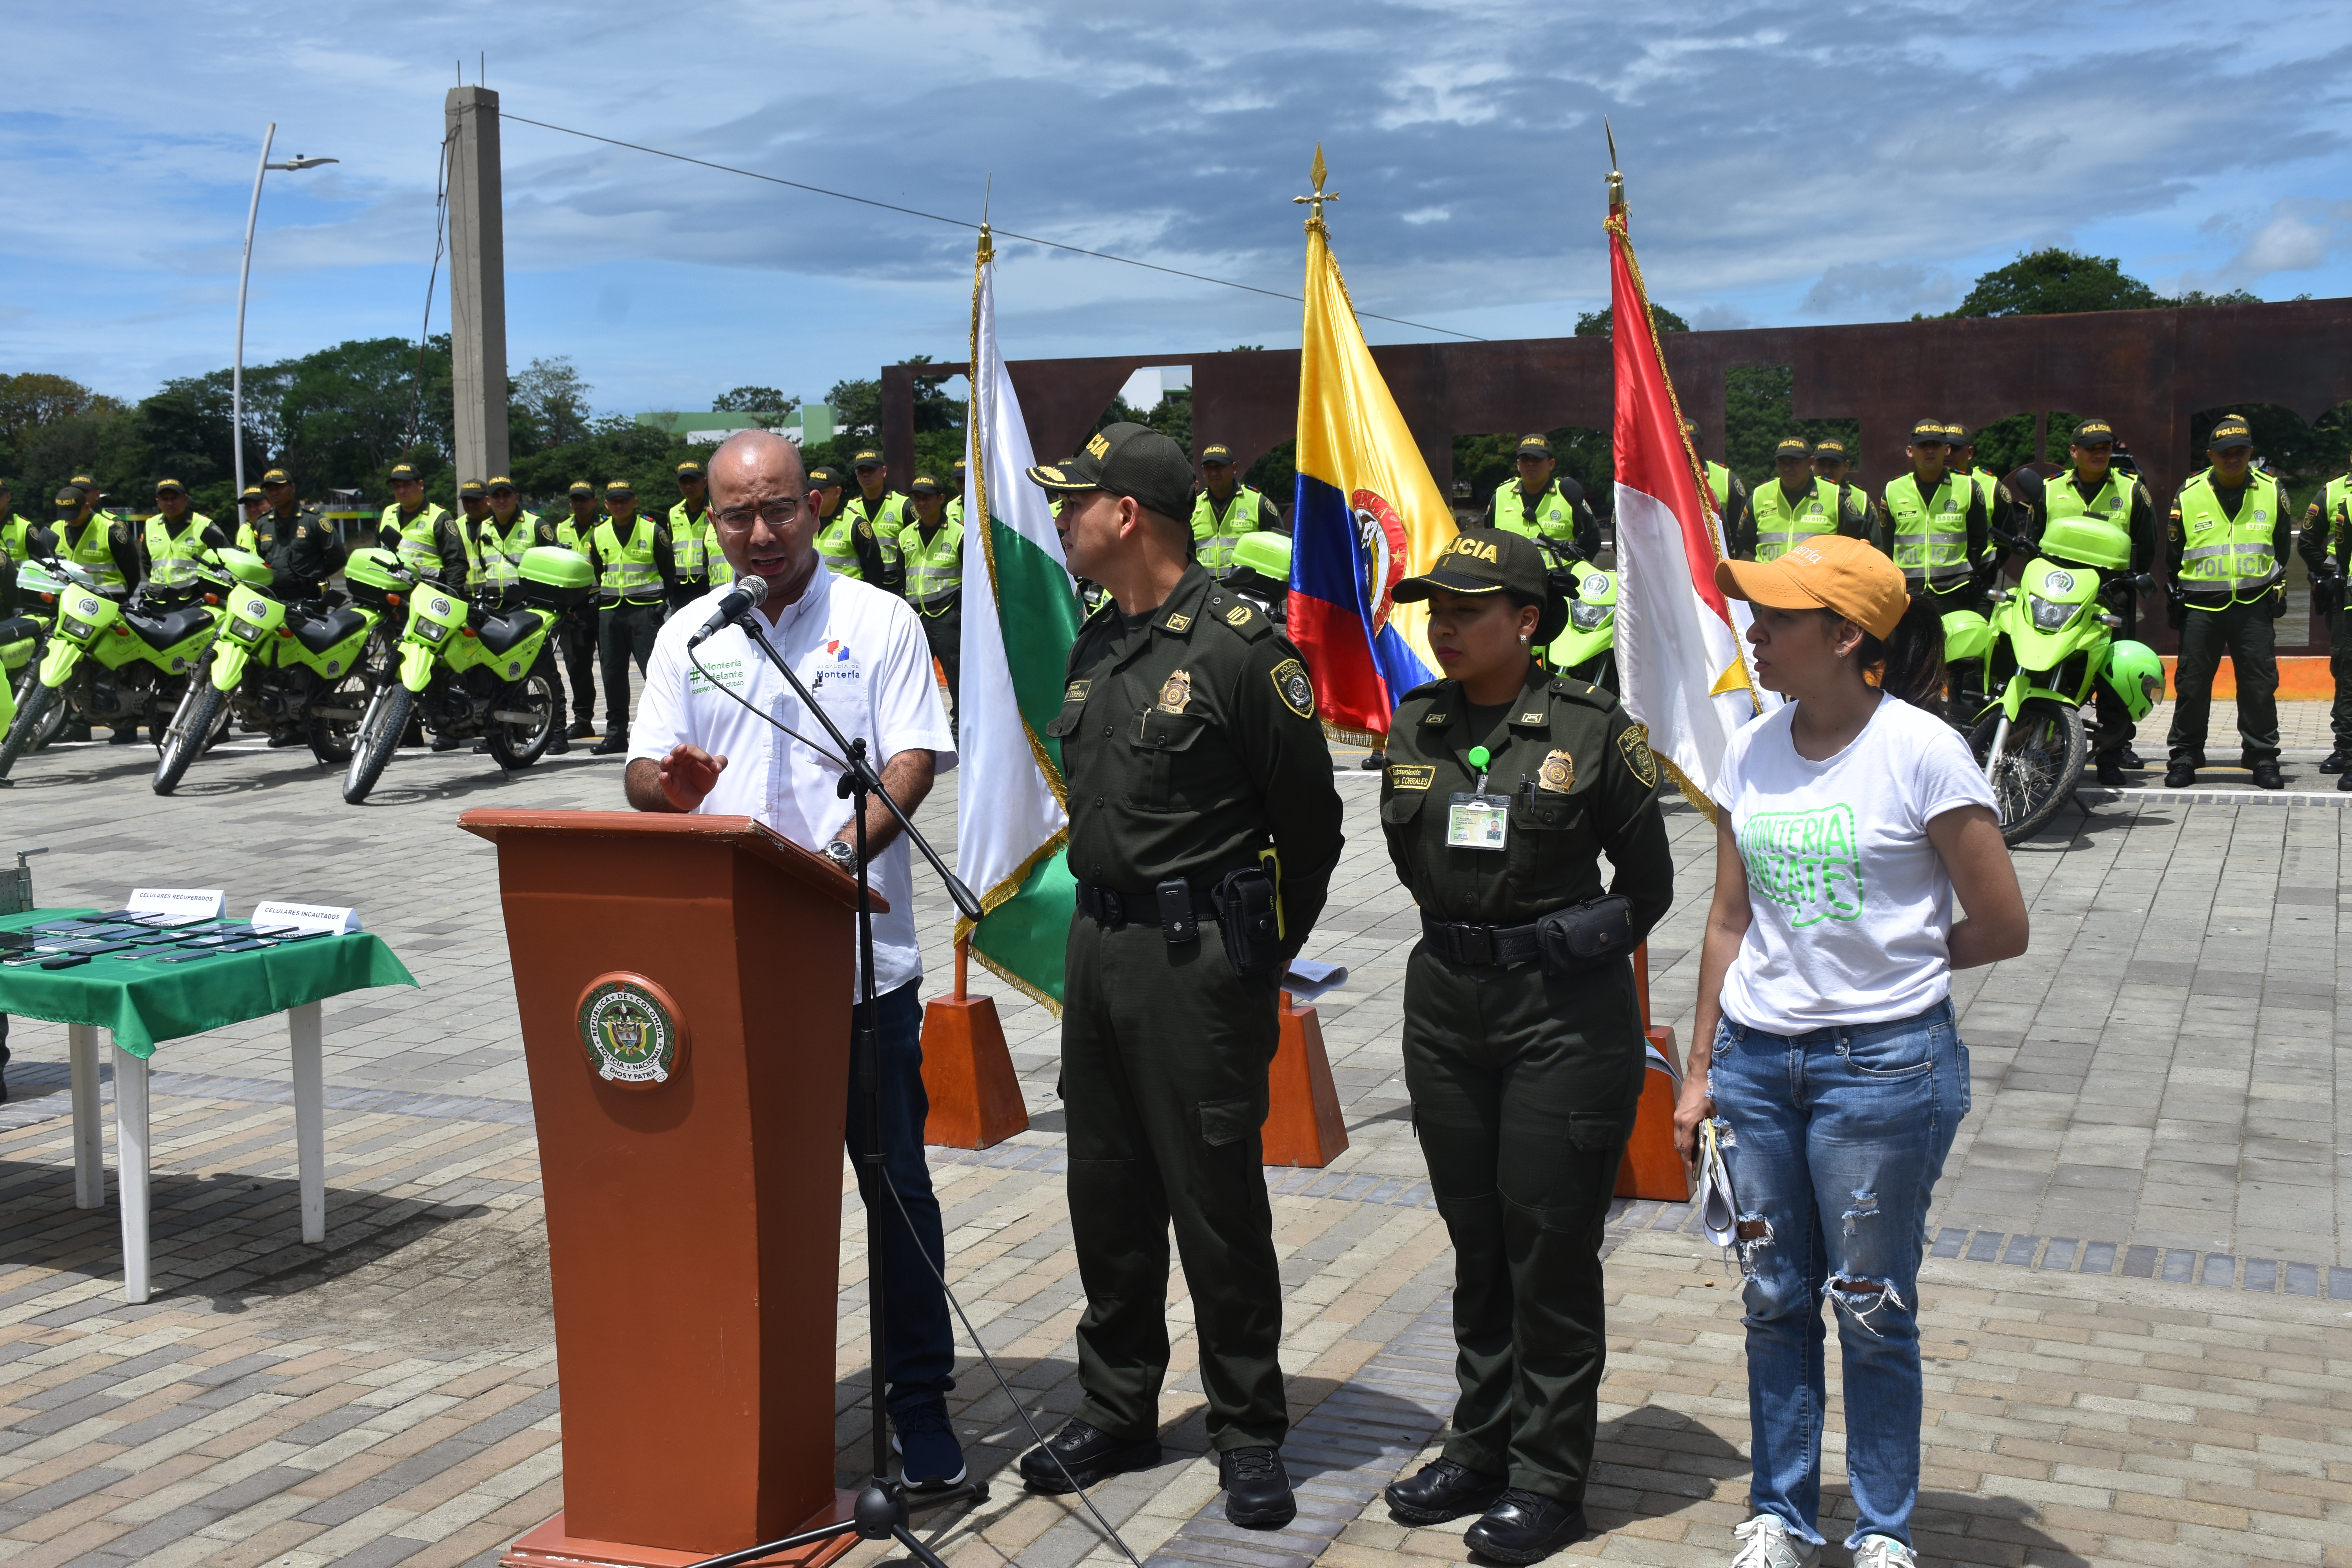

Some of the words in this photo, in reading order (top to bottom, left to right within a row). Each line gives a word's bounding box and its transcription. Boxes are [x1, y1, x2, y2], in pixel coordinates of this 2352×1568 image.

[1915, 425, 1944, 433] POLICIA
[2216, 423, 2248, 437] POLICIA
[1521, 437, 1545, 447] POLICIA
[1779, 439, 1804, 449] POLICIA
[1817, 442, 1843, 451] POLICIA
[856, 452, 876, 461] POLICIA
[1203, 446, 1227, 456] POLICIA
[1437, 537, 1497, 564] LICIA
[115, 635, 137, 646] POLICIA
[703, 659, 742, 671] Montería
[1280, 662, 1298, 675] POLICIA
[817, 670, 860, 679] Montería
[692, 686, 710, 695] GOBIERNO
[1401, 777, 1428, 785] CORRALES
[1746, 813, 1849, 856] MONTERIA
[265, 907, 300, 916] CELULARES
[301, 910, 340, 920] INCAUTADOS
[636, 998, 663, 1038] COLOMBIA
[633, 1047, 662, 1070] NACIONAL
[634, 1069, 657, 1080] PATRIA
